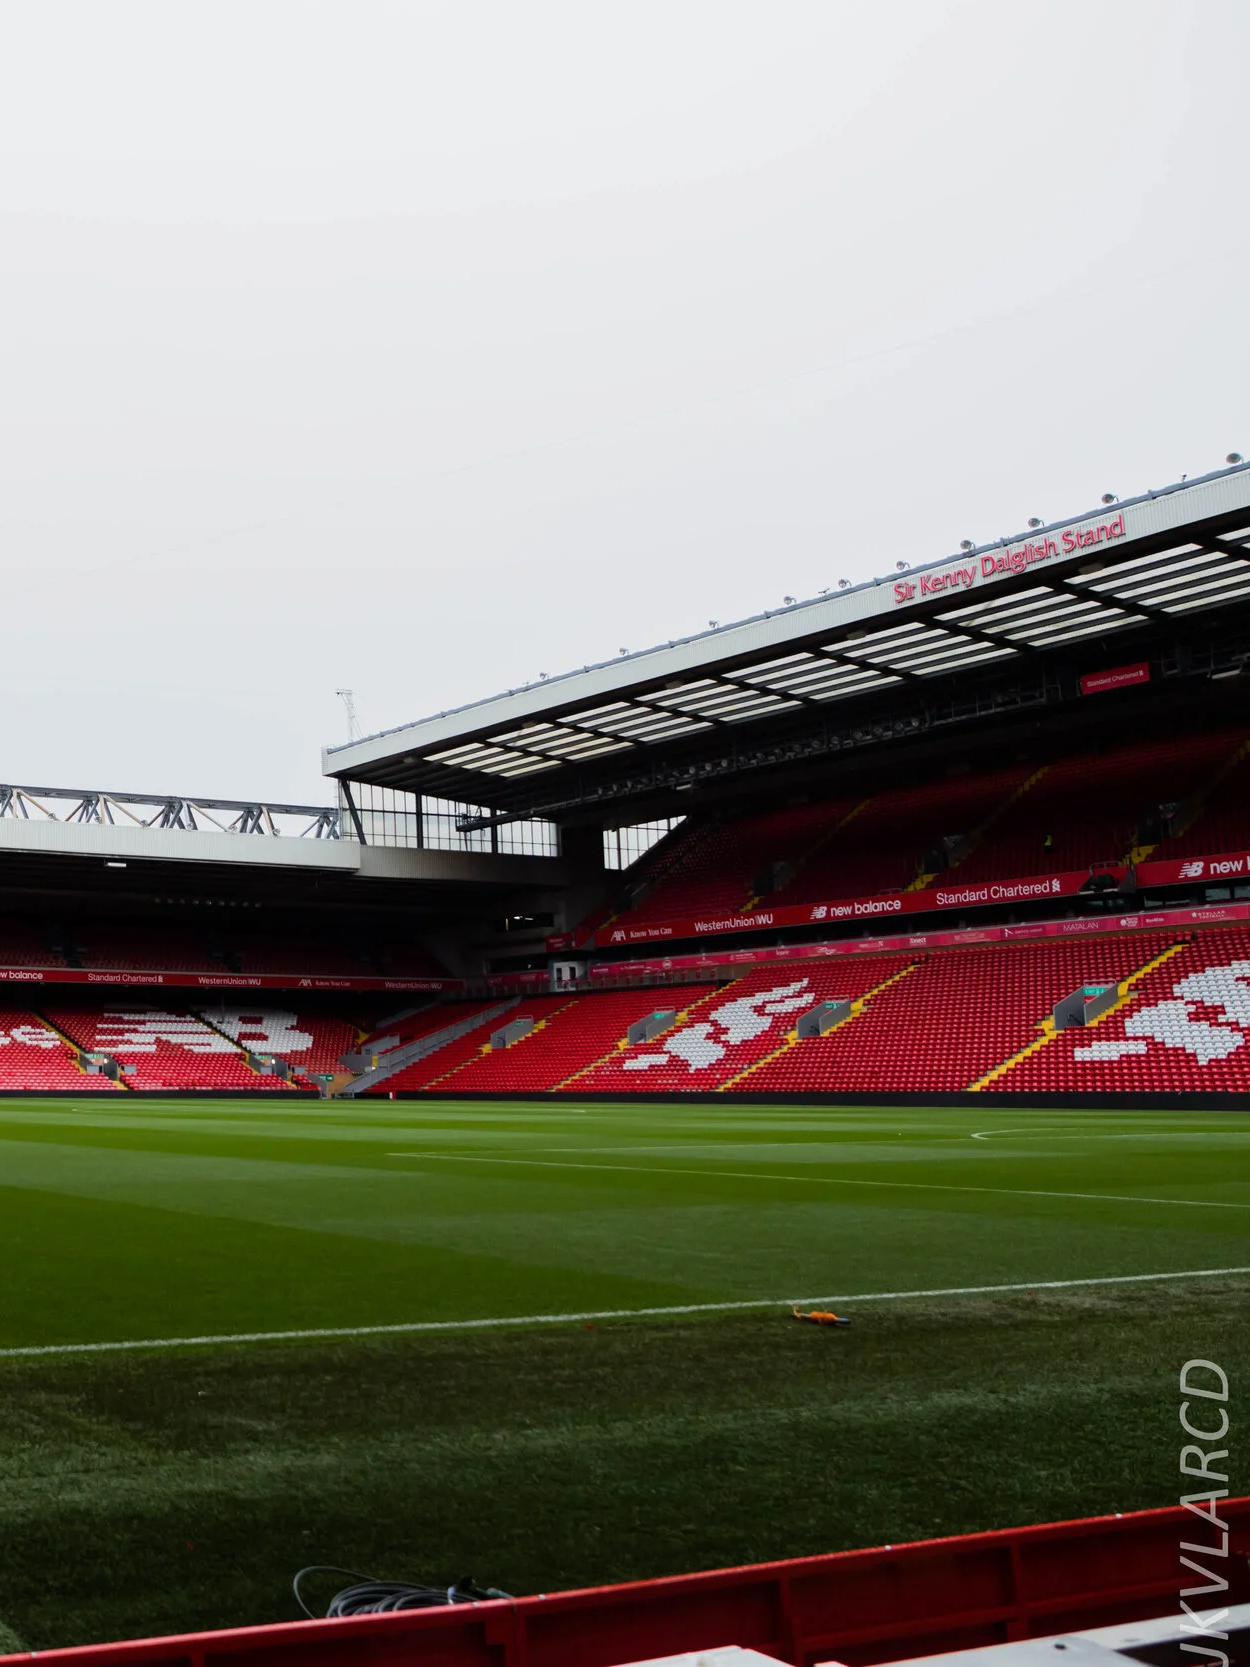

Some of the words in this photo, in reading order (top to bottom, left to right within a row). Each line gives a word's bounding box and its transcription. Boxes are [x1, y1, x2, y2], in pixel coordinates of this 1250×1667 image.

[893, 581, 916, 604] Sir
[919, 565, 976, 596] Kenny
[980, 538, 1058, 578] Dalglish
[1061, 514, 1126, 552] Stand
[1209, 859, 1243, 875] new
[936, 889, 987, 905] Standard
[990, 880, 1050, 899] Chartered
[830, 905, 853, 917] new
[854, 900, 901, 915] balance
[694, 917, 755, 933] WesternUnion
[1062, 921, 1099, 932] MATALAN
[610, 929, 626, 942] AXA
[630, 930, 647, 939] Know
[648, 928, 660, 937] You
[660, 927, 672, 936] Can
[8, 970, 43, 979] balance
[88, 973, 121, 982] Standard
[121, 974, 158, 983] Chartered
[197, 976, 247, 985] WesternUnion
[298, 978, 312, 987] AXA
